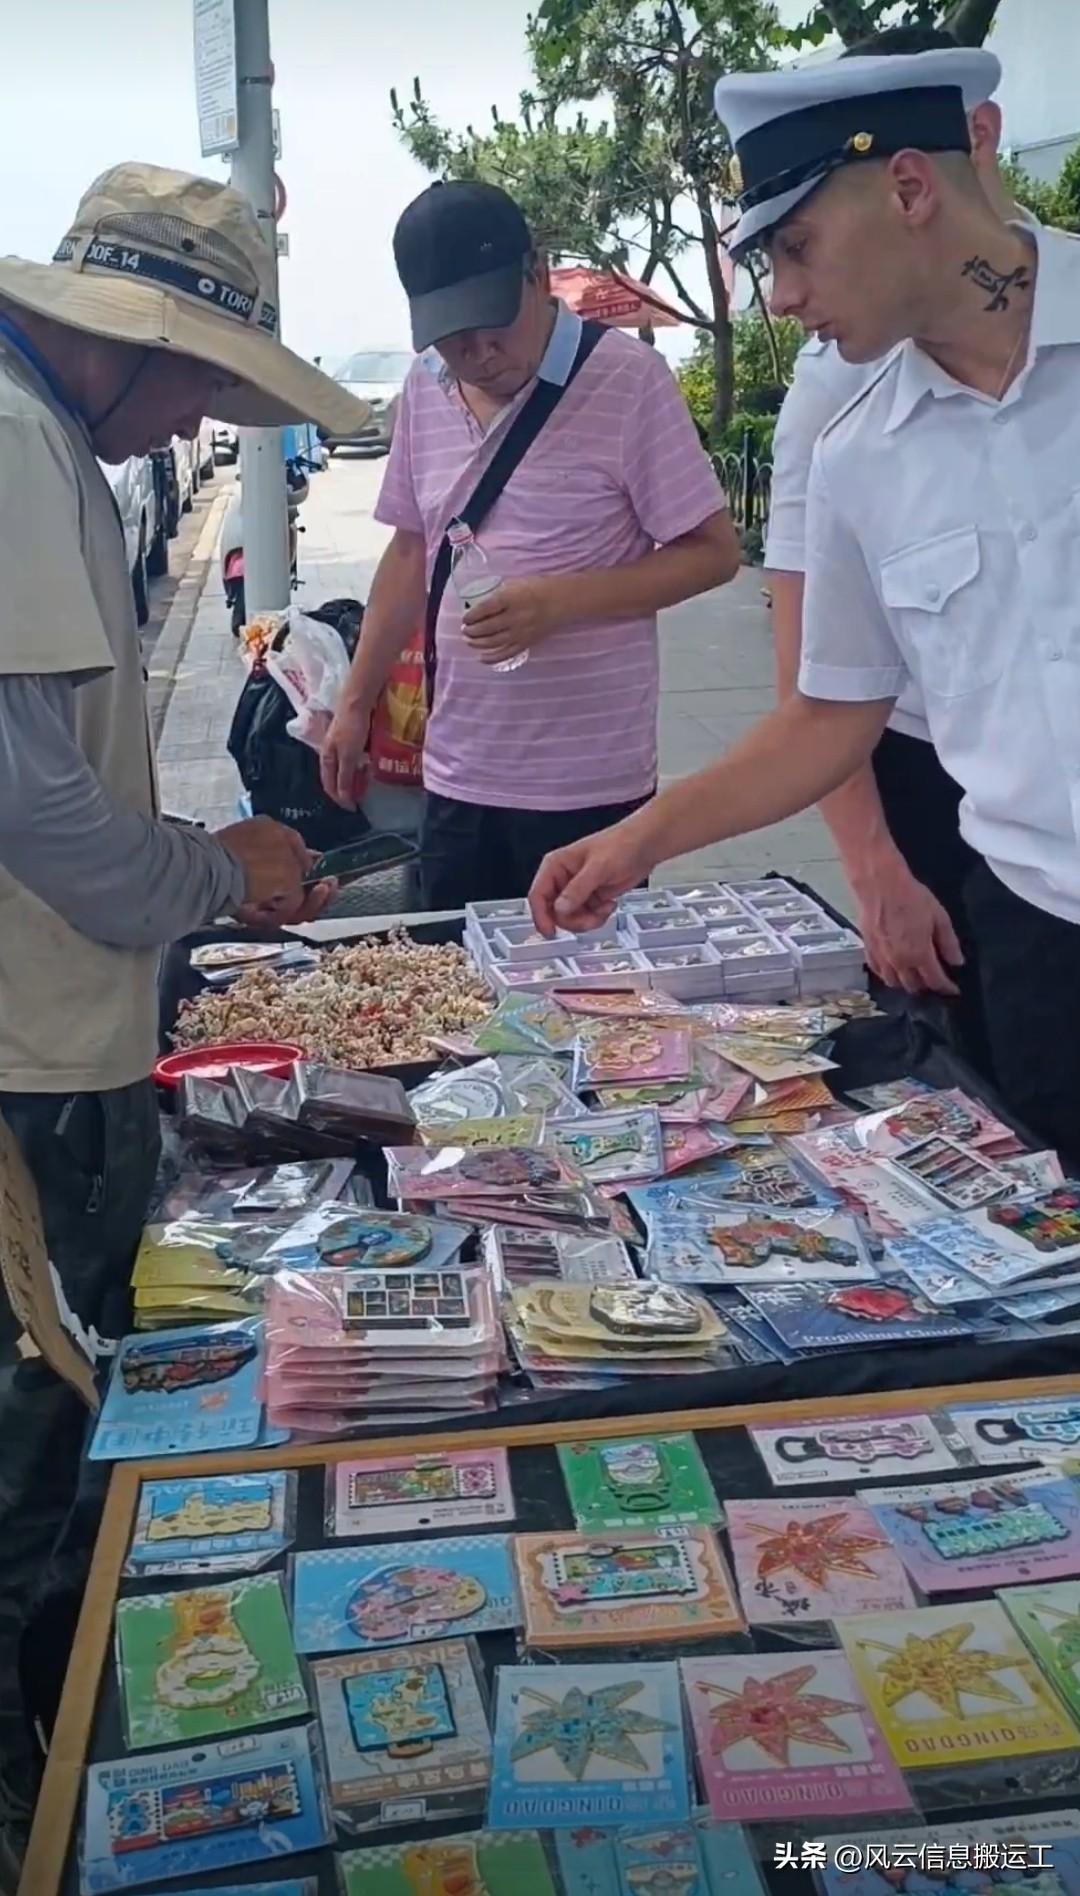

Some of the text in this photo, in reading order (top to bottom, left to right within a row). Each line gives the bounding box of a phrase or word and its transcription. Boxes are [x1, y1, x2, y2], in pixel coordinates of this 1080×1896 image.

[904, 1728, 1017, 1754] QINGDAO
[504, 1794, 622, 1816] QINGDAO
[722, 1781, 844, 1806] QINGDAO
